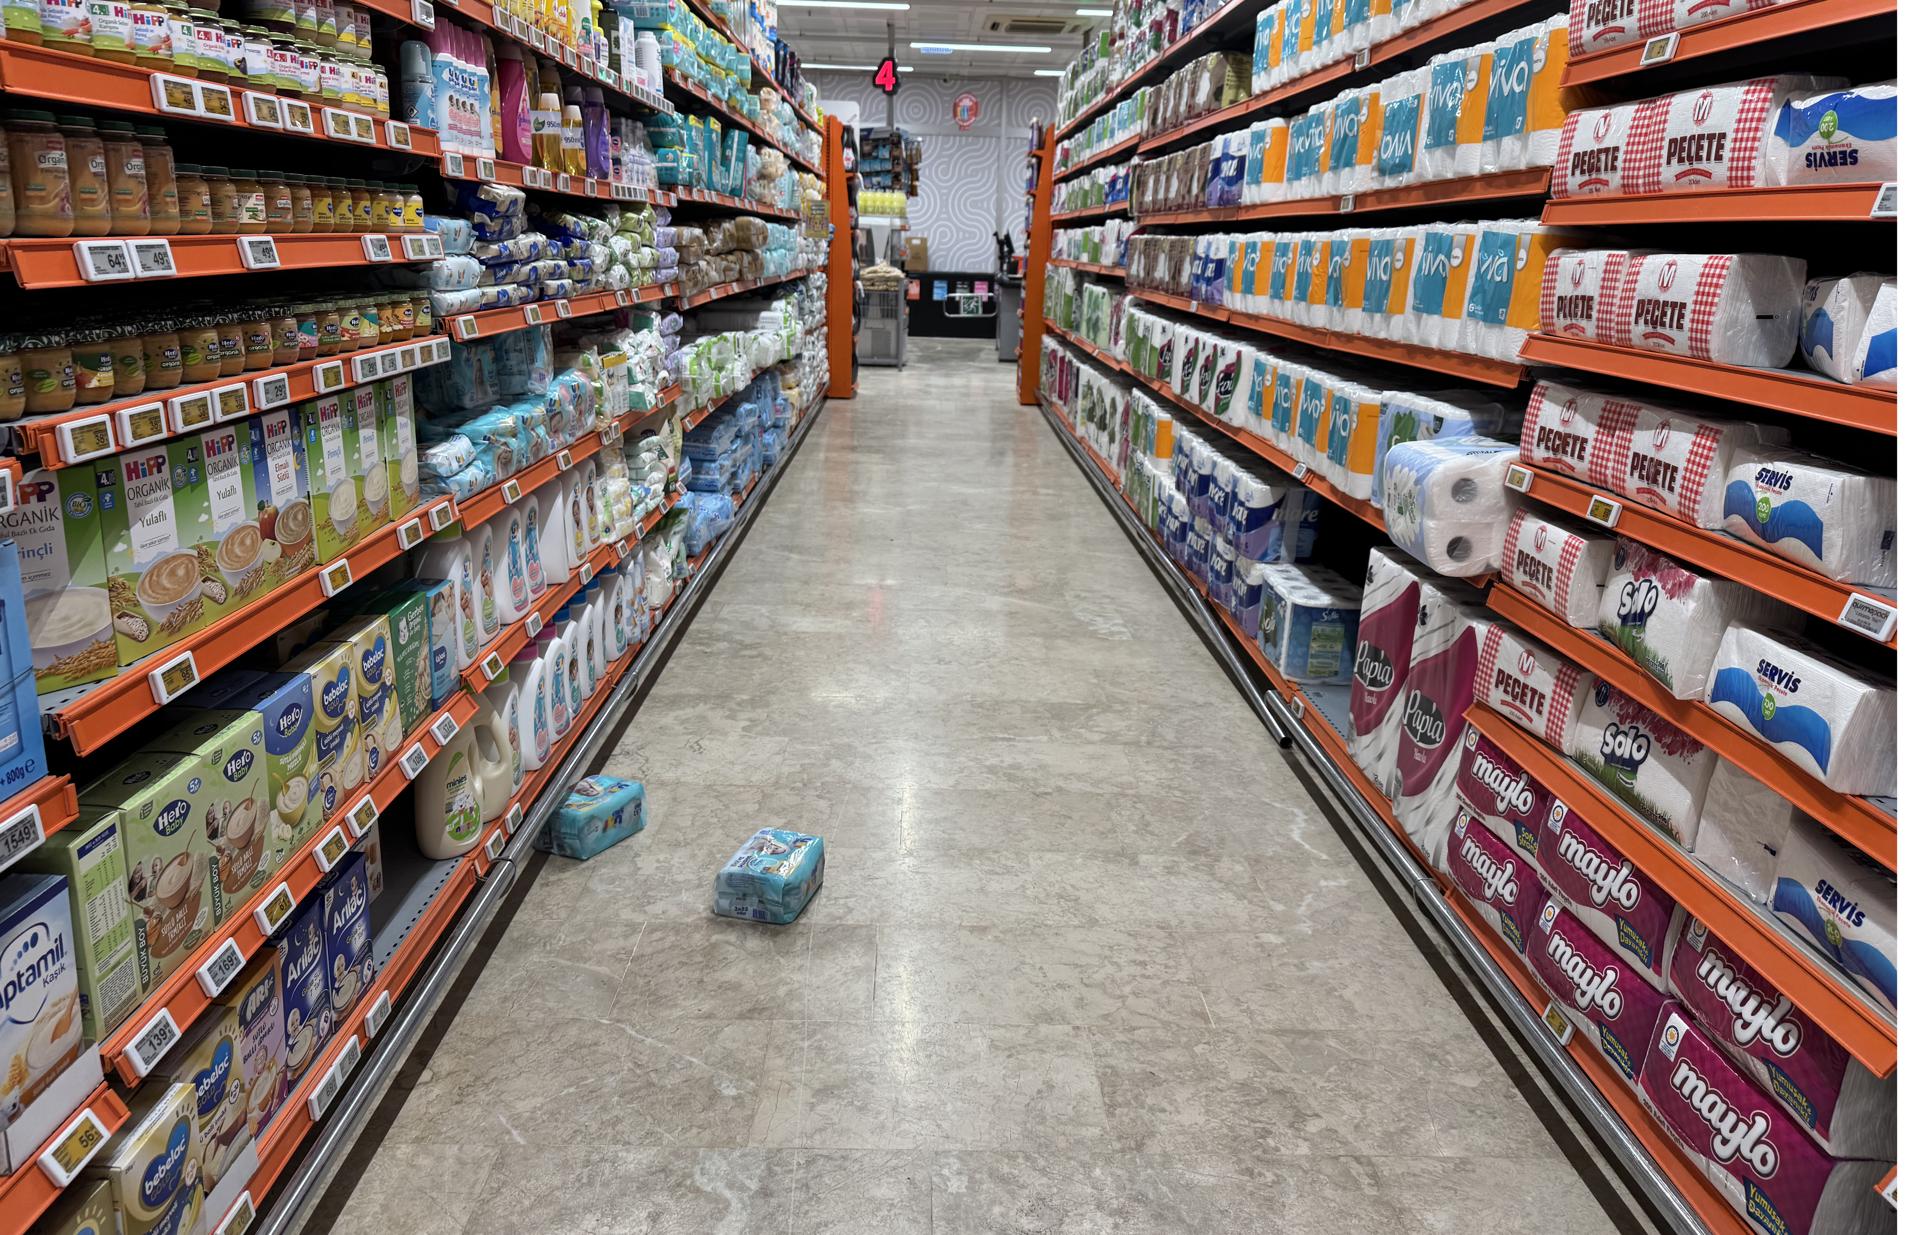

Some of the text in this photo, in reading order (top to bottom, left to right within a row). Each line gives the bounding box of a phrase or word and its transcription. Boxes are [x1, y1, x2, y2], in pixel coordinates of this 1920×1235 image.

[133, 14, 164, 26] HiPP
[301, 58, 318, 70] HiPP
[875, 61, 896, 91] 4
[1489, 57, 1528, 96] viva
[1571, 146, 1619, 177] PEÇETE
[1667, 132, 1726, 166] PEÇETE
[1805, 149, 1859, 172] SERVİS
[1367, 252, 1391, 282] viva
[1658, 262, 1677, 289] M
[1634, 298, 1687, 330] PEÇETE
[320, 403, 339, 422] HiPP
[357, 391, 373, 410] HiPP
[266, 420, 287, 439] HiPP
[205, 434, 236, 458] HiPP
[1536, 426, 1589, 462] PEÇETE
[125, 454, 167, 481] HiPP
[206, 455, 239, 476] ORGANİK
[1630, 450, 1679, 492] PEÇETE
[19, 481, 56, 505] PP
[127, 477, 171, 501] ORGANİK
[216, 485, 237, 501] Yulaflı
[0, 506, 59, 528] RGANİK
[138, 511, 167, 528] Yulaflı
[1516, 548, 1554, 591] PEÇETE
[362, 648, 384, 672] bebelac
[1355, 640, 1393, 685] Papia
[1517, 652, 1535, 673] M
[1756, 658, 1802, 693] SERVİS
[323, 678, 349, 704] bebelac
[1494, 667, 1546, 716] PEÇETE
[279, 706, 302, 732] Hero
[1403, 689, 1444, 743] Papia
[1600, 722, 1651, 766] Solo
[226, 751, 252, 778] Hero
[233, 764, 250, 783] Baby
[1473, 751, 1534, 816] maylo
[157, 800, 188, 832] Hero
[164, 815, 185, 837] Baby
[4, 825, 33, 853] 1549
[1460, 834, 1519, 906] maylo
[1559, 829, 1641, 911] maylo
[1815, 879, 1866, 927] SERVİS
[42, 962, 66, 988] Kaşık
[1547, 930, 1623, 1020] maylo
[1697, 947, 1802, 1058] maylo
[1671, 1058, 1779, 1180] maylo
[144, 1135, 187, 1196] bebelac
